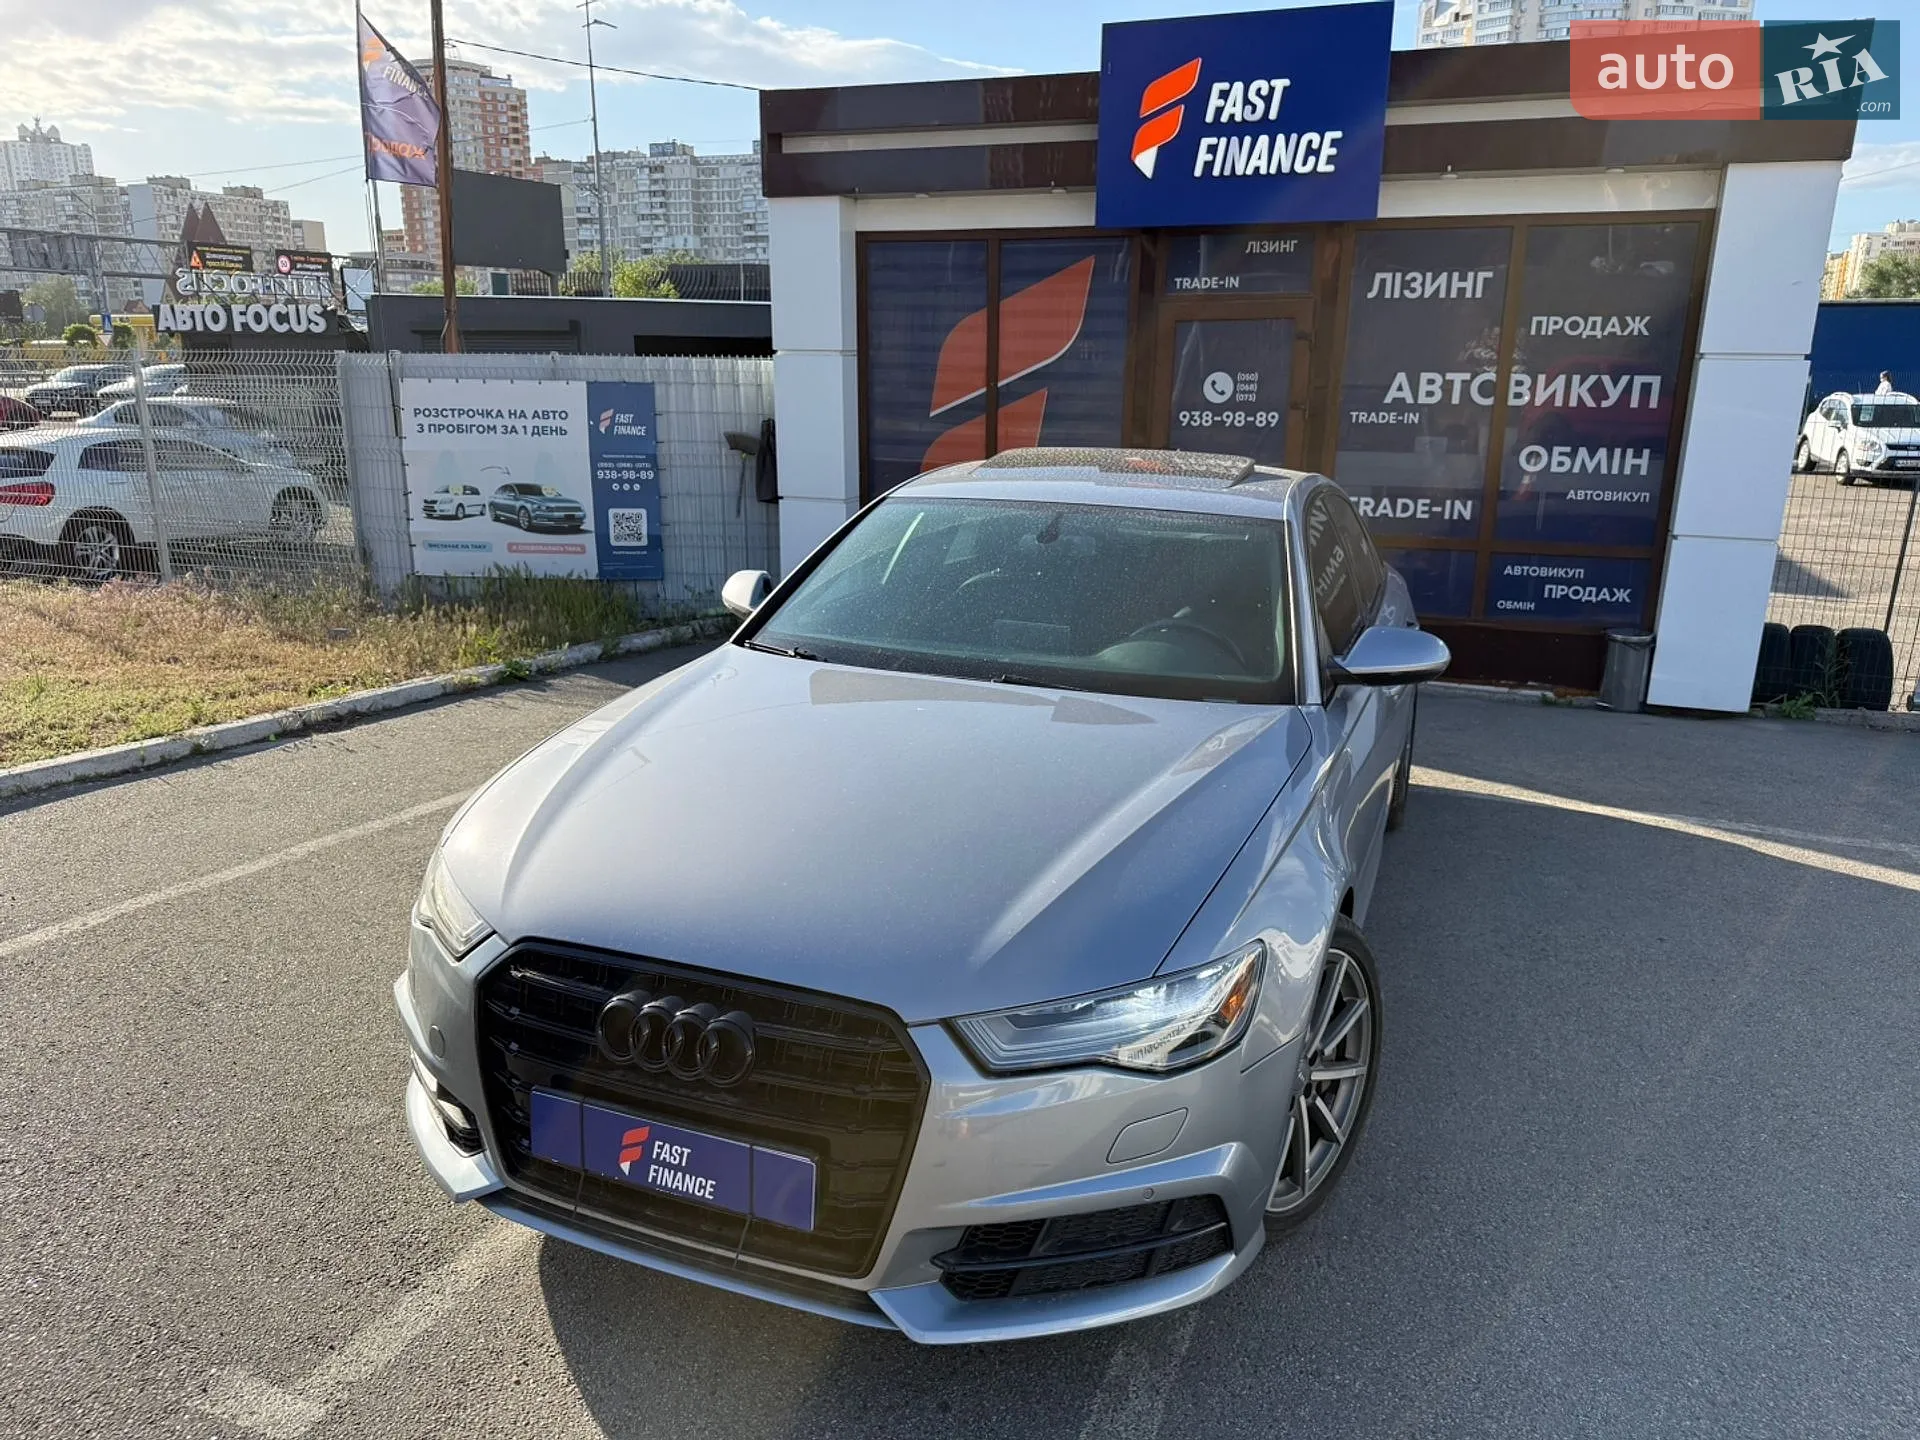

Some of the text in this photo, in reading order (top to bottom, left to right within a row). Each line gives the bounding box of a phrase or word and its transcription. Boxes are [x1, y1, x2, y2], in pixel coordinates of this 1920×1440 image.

[1204, 78, 1291, 123] FAST
[1193, 130, 1343, 178] FINANCE
[1245, 240, 1298, 254] ЛІЗИНГ
[1174, 276, 1240, 289] TRADE-IN
[1367, 271, 1493, 299] ЛІЗИНГ
[157, 303, 327, 334] АВТО FOCUS
[1530, 315, 1651, 339] ПРОДАЖ
[1383, 371, 1662, 409] АВТОВИКУП
[413, 407, 569, 420] РОЗСТРОЧКА НА АВТО
[614, 413, 634, 424] FAST
[1178, 410, 1280, 427] 938-98-89
[1350, 411, 1419, 424] TRADE-IN
[428, 423, 497, 435] ПРОБІГОМ
[501, 424, 518, 435] ЗА
[522, 425, 527, 435] 1
[531, 425, 568, 437] ДЕНЬ
[613, 425, 647, 436] FINANCE
[1519, 445, 1650, 476] ОБМІН
[597, 470, 654, 480] 938-98-89
[1566, 489, 1650, 502] АВТОВИКУП
[1503, 565, 1584, 579] АВТОВИКУП
[1544, 584, 1631, 603] ПРОДАЖ
[1497, 600, 1535, 611] ОБМІН
[652, 1140, 692, 1167] FAST
[648, 1164, 717, 1200] FINANCE
